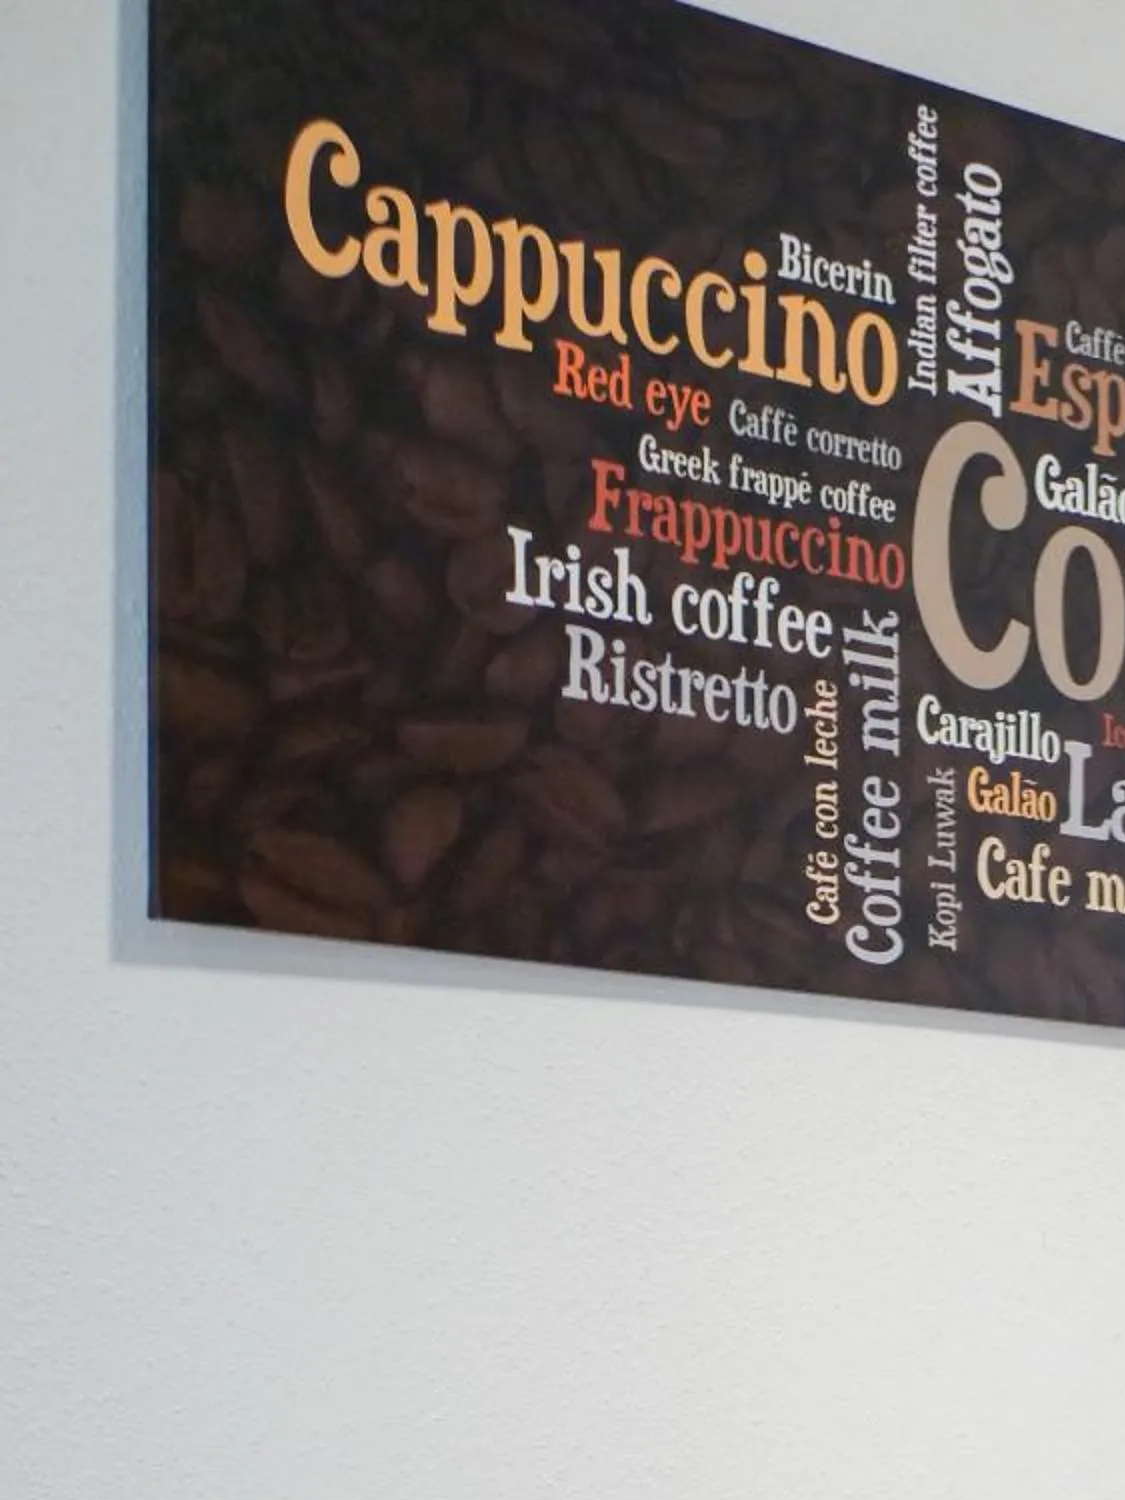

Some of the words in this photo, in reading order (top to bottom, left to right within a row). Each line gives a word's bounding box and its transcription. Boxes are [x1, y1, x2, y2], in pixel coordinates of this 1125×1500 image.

[907, 104, 938, 197] coffee
[284, 117, 899, 406] Cappuccino
[778, 233, 896, 305] Bicerin
[907, 203, 938, 285] filter
[945, 162, 1014, 418] Affogato
[553, 339, 631, 409] Red
[645, 378, 712, 432] eye
[907, 294, 938, 397] Indian
[638, 434, 721, 486] Greek
[819, 479, 897, 524] coffee
[806, 427, 903, 471] corretto
[587, 459, 905, 591] Frappuccino
[505, 525, 652, 625] Irish
[671, 571, 833, 658] coffee
[561, 624, 798, 735] Ristretto
[805, 679, 839, 771] leche
[843, 608, 900, 757] milk
[916, 693, 1061, 765] Carajillo
[813, 781, 839, 841] con
[926, 767, 958, 872] Luwak
[967, 765, 1057, 823] Galão
[844, 776, 904, 965] Coffee
[928, 882, 961, 951] Kopi
[976, 836, 1072, 907] Cafe
